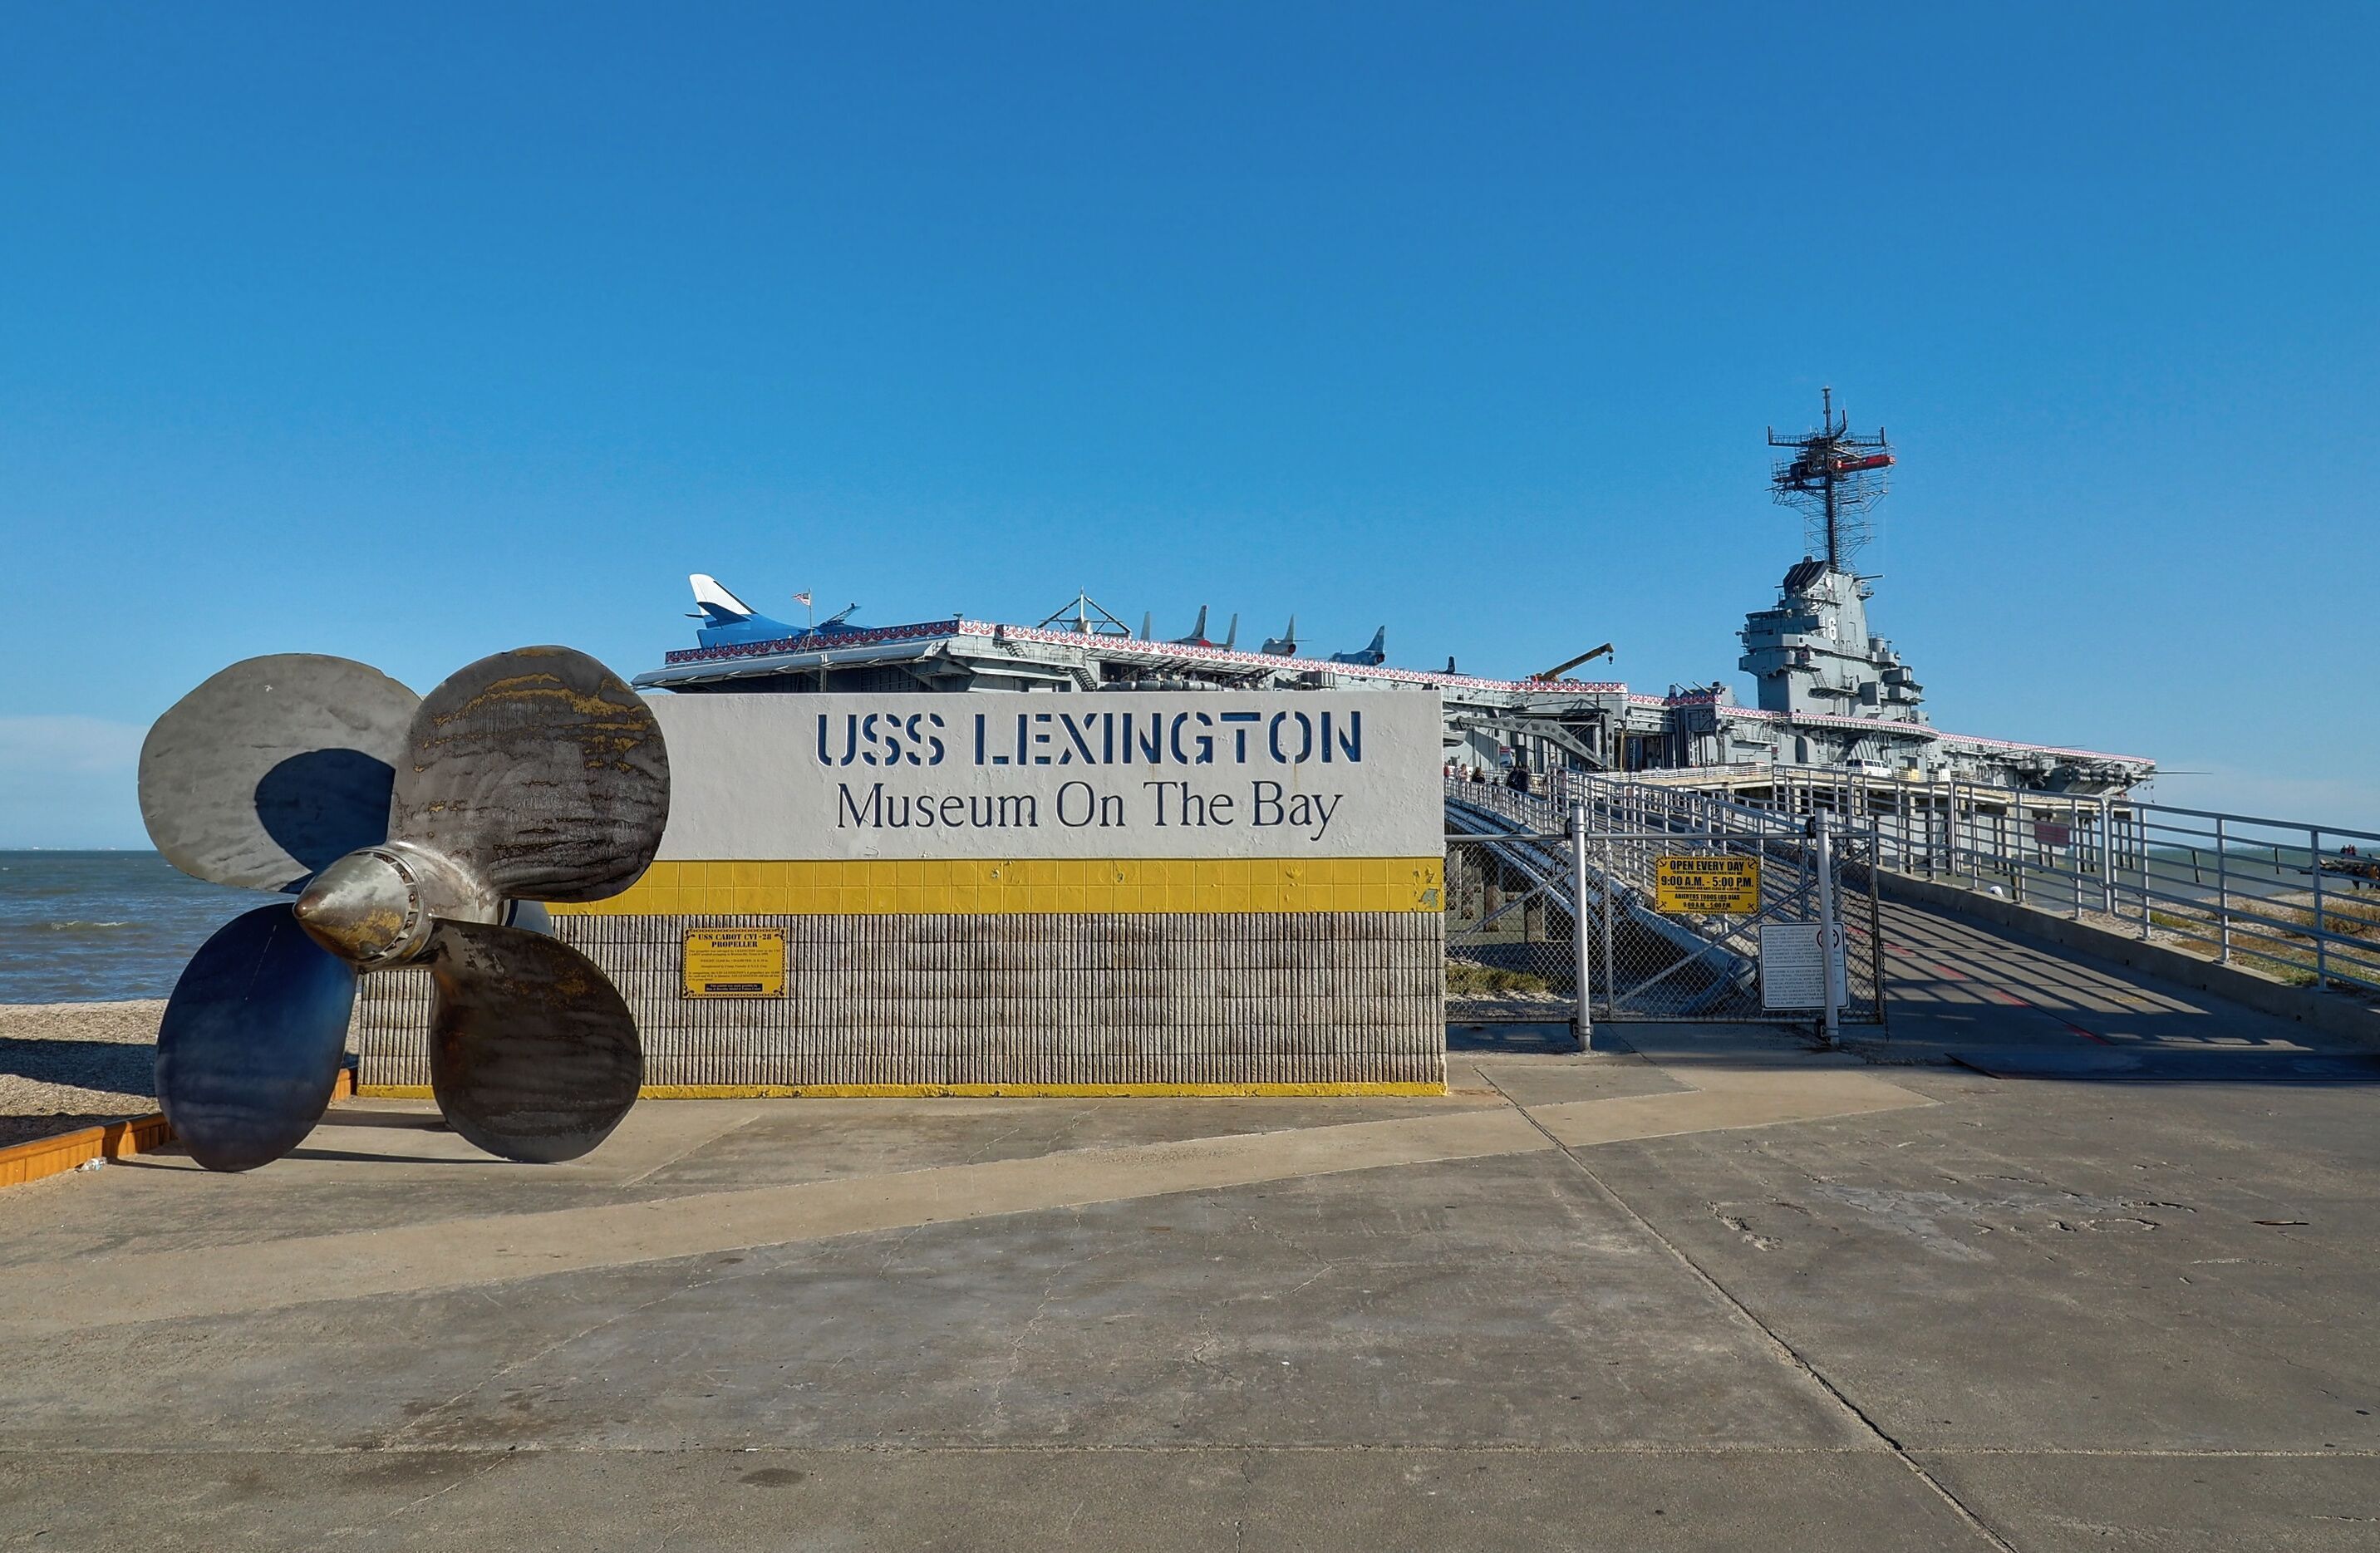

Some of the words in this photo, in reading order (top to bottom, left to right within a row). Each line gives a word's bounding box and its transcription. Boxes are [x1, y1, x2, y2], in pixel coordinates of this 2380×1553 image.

[1822, 616, 1837, 641] 16
[816, 713, 945, 766] USS
[974, 711, 1361, 765] LEXINGTON
[837, 783, 1039, 828] Museum
[1055, 781, 1125, 827] On
[1142, 781, 1234, 826] The
[1251, 780, 1343, 841] Bay
[1670, 860, 1694, 870] OPEN
[1696, 861, 1724, 871] EVERY
[1727, 861, 1744, 872] DAY
[1661, 876, 1683, 886] 9:00
[1684, 877, 1704, 886] A.M.
[1713, 877, 1733, 887] 5:00
[1737, 877, 1753, 887] P.M.
